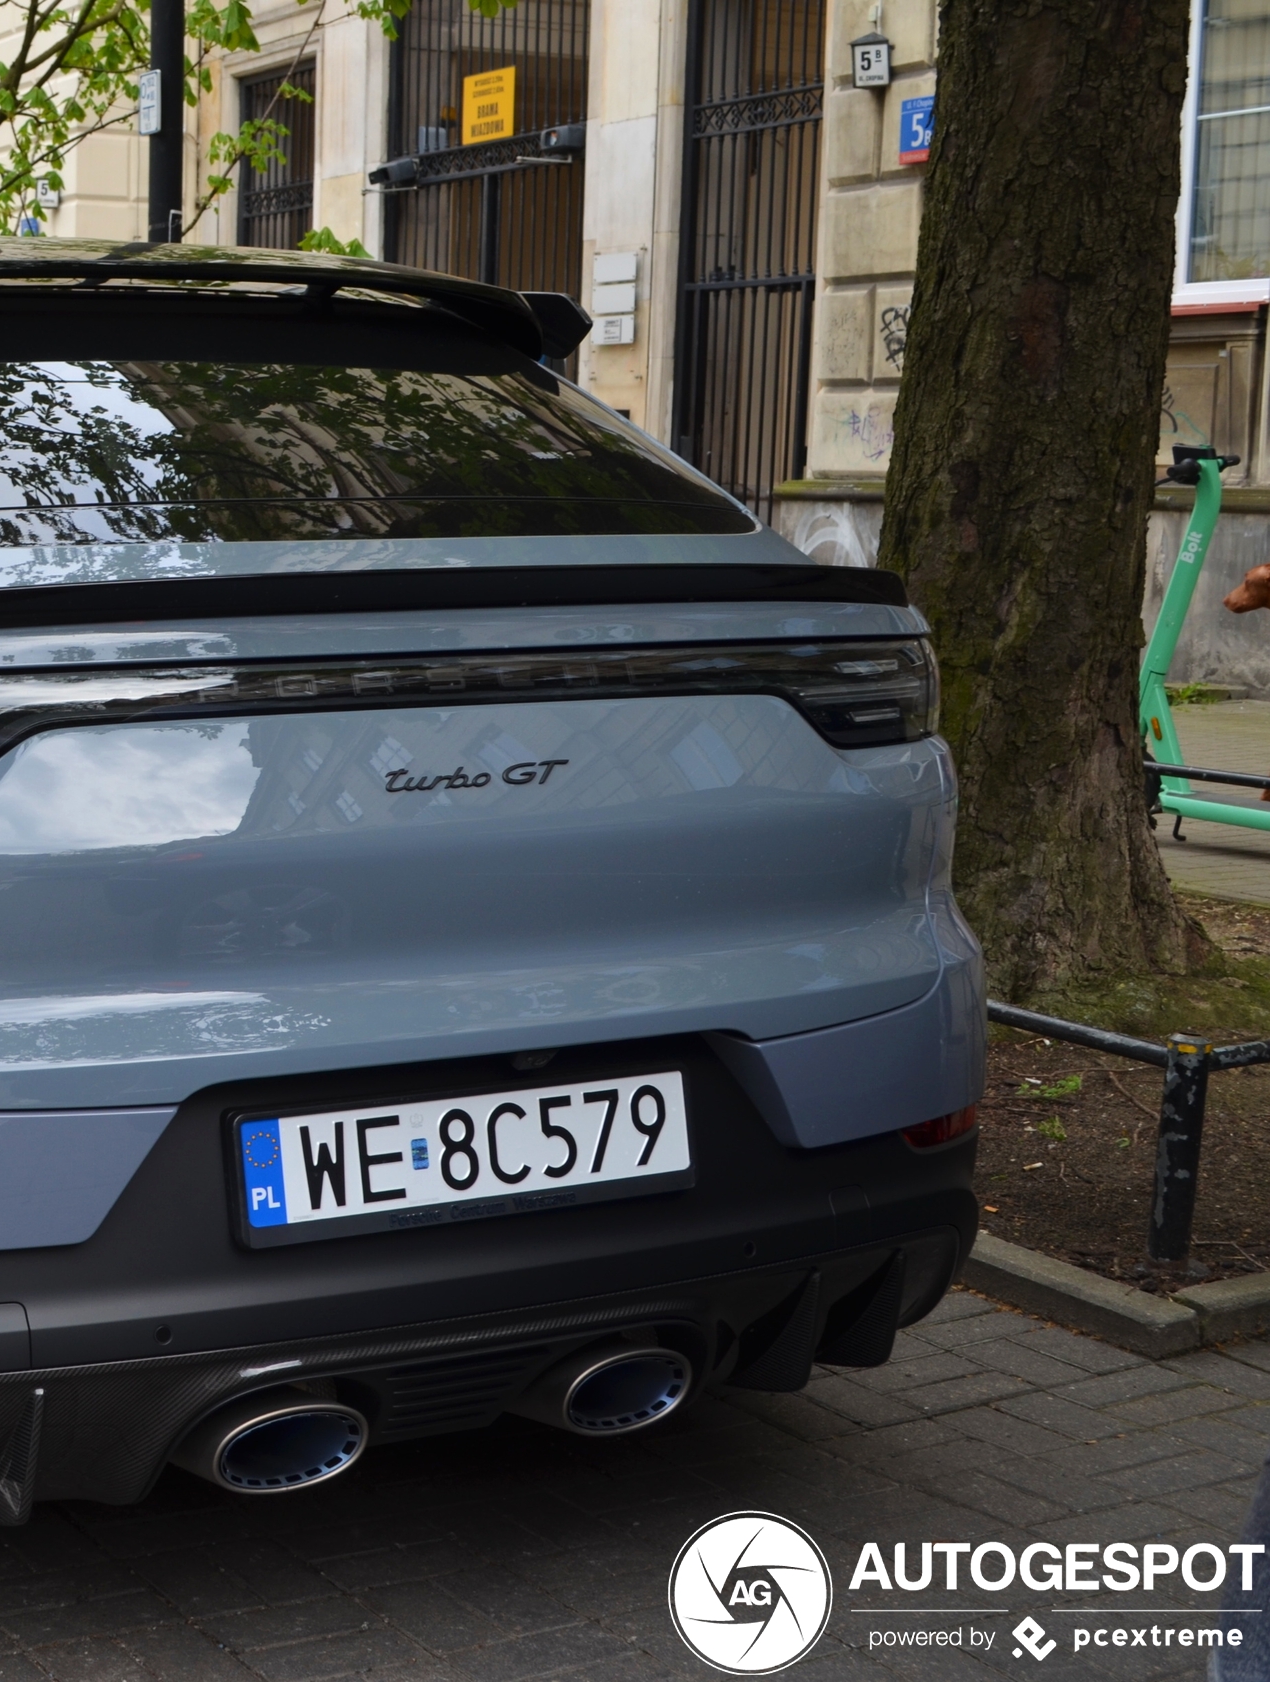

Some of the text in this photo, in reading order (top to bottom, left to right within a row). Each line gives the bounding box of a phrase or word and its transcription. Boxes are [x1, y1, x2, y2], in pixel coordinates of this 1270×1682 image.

[477, 102, 498, 119] BRAMA
[1180, 531, 1203, 564] Bolt
[385, 759, 570, 793] turbo GT
[252, 1084, 667, 1211] PL WE 8C579
[389, 1191, 577, 1228] Porsche Centrum Warszawa
